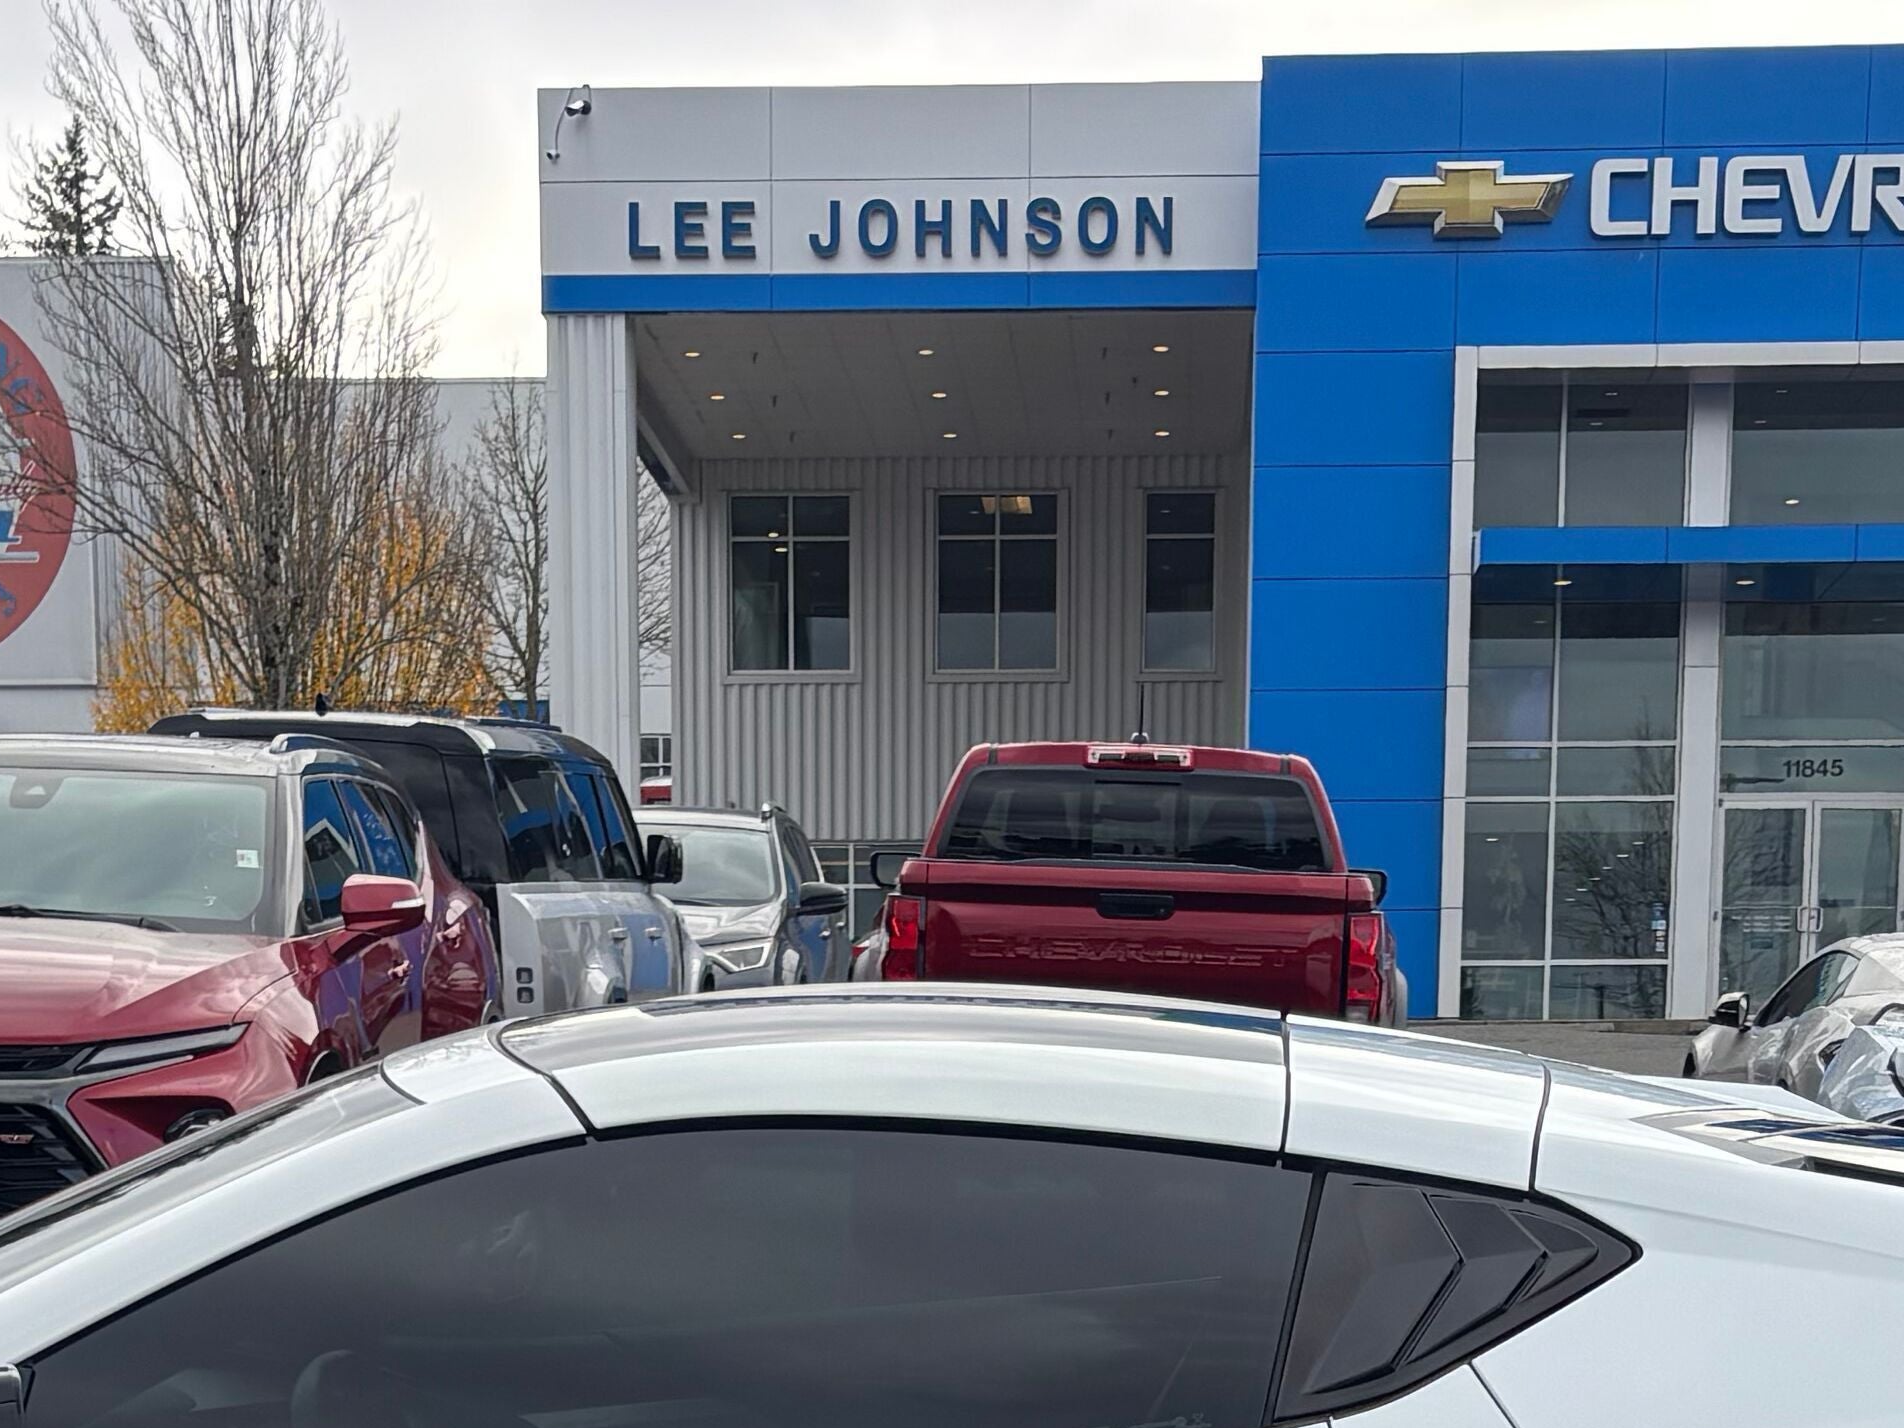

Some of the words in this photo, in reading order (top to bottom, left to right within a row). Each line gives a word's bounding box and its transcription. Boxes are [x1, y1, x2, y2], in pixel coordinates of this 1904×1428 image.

[628, 200, 757, 260] LEE
[809, 196, 1174, 259] JOHNSON
[1782, 759, 1844, 778] 11845
